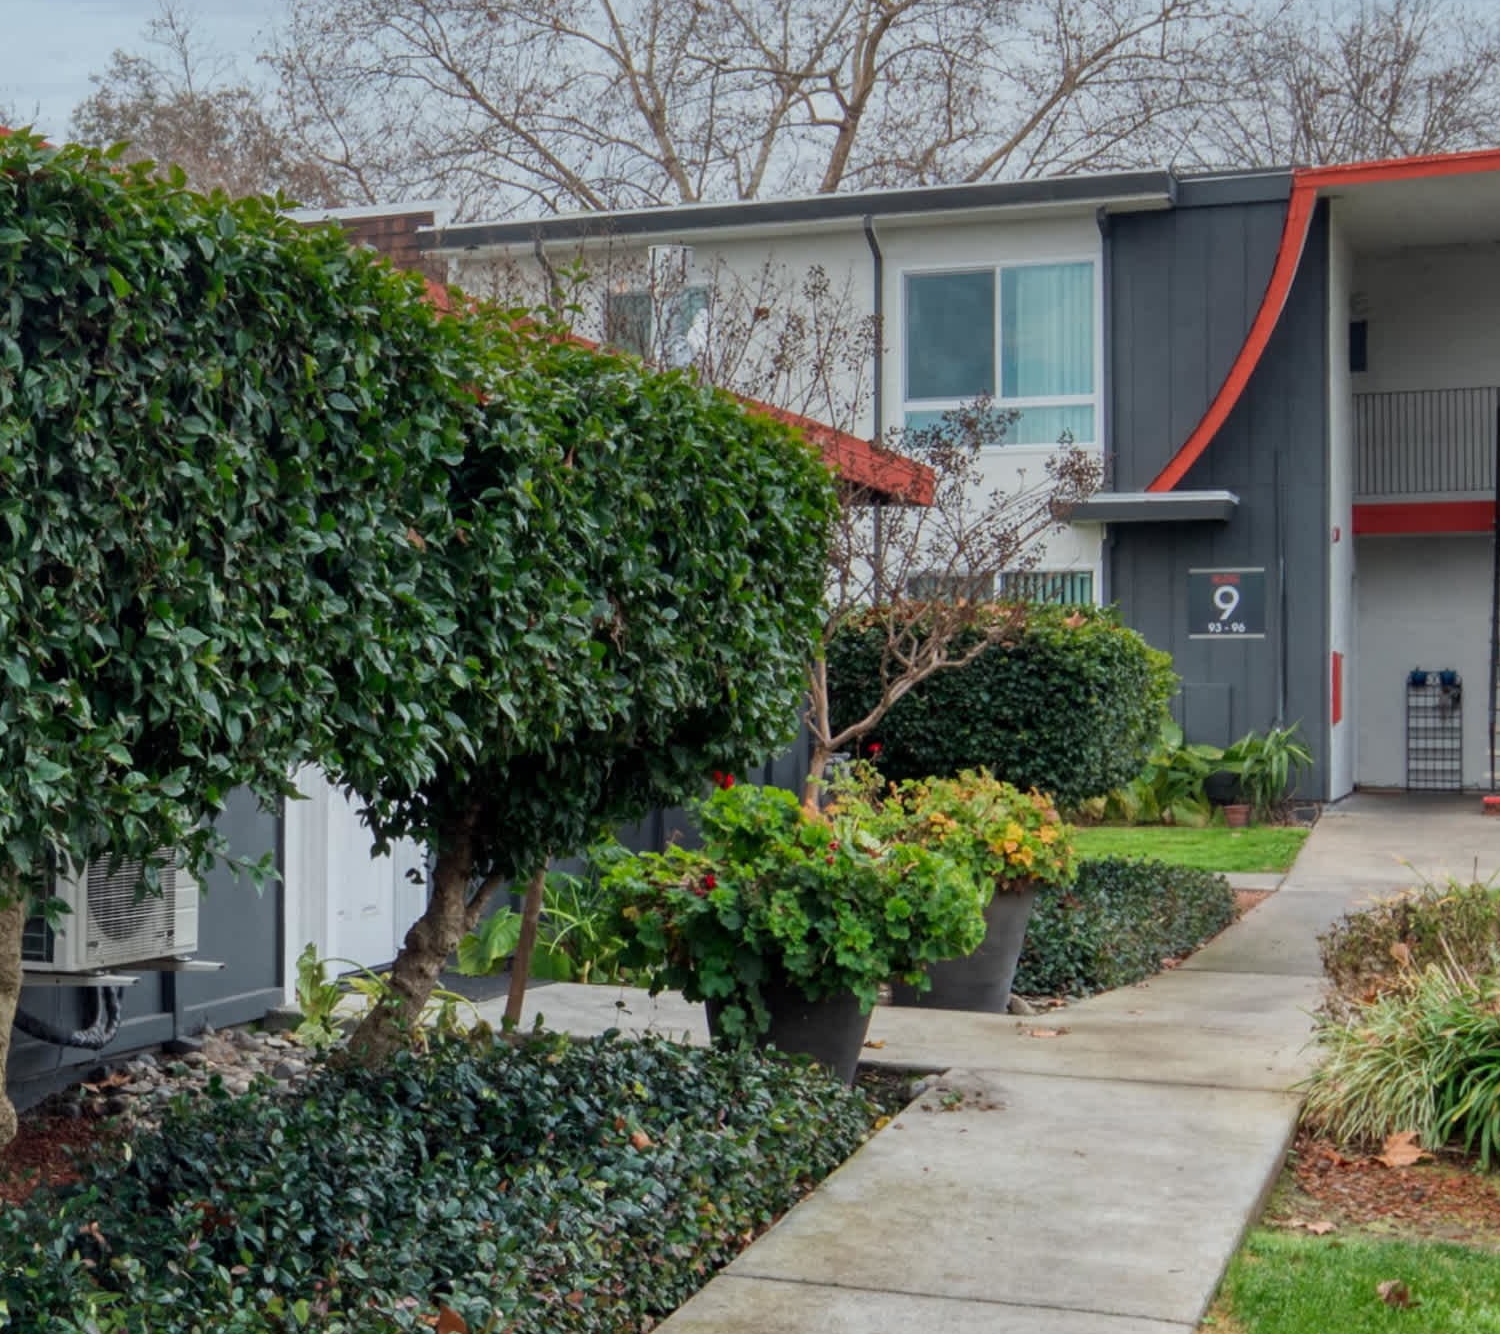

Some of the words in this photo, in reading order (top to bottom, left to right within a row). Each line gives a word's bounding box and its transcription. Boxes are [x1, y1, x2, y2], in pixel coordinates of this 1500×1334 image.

[1213, 585, 1240, 620] 9
[1208, 622, 1222, 633] 93
[1231, 622, 1246, 633] 96
